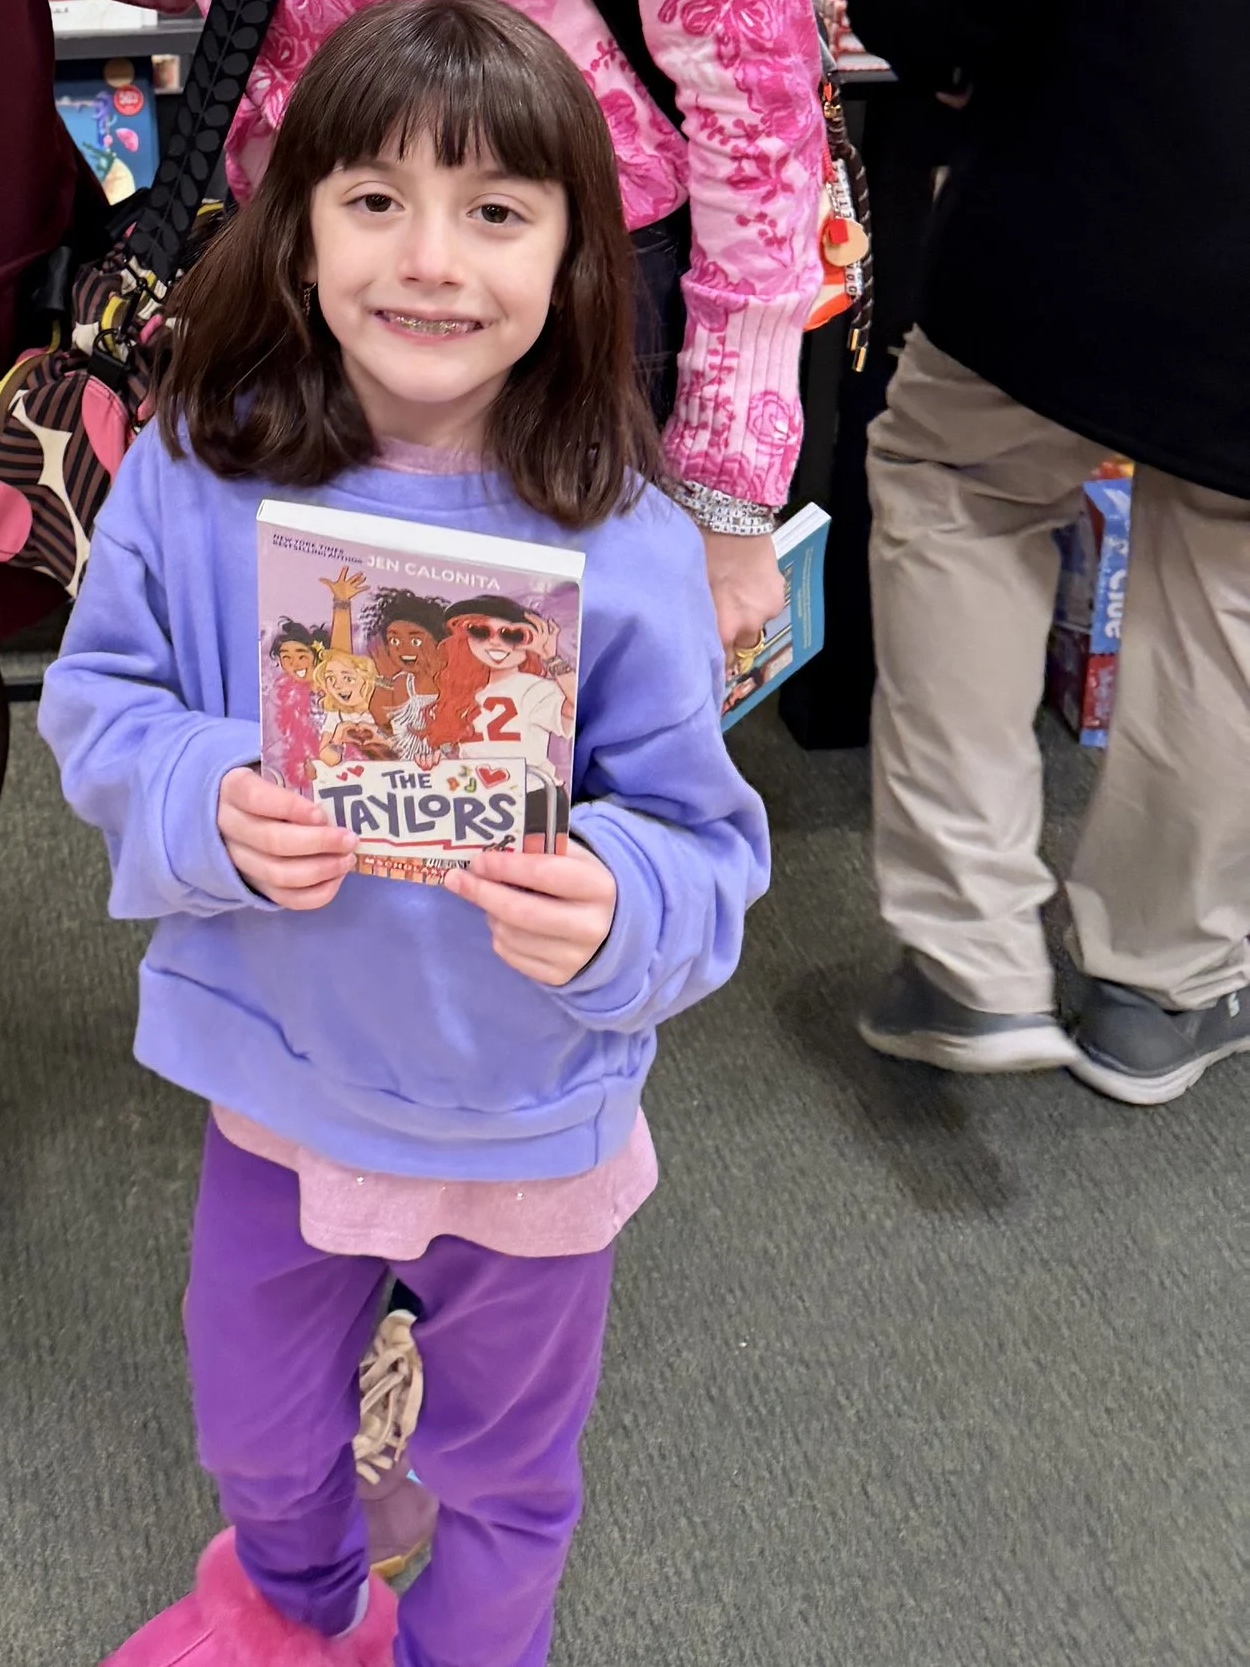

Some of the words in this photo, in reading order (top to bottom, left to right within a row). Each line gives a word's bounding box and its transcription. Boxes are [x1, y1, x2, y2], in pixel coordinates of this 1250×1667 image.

[367, 554, 400, 574] JEN
[404, 562, 500, 591] CALONITA
[382, 770, 433, 790] THE
[318, 784, 518, 841] TAYLORS
